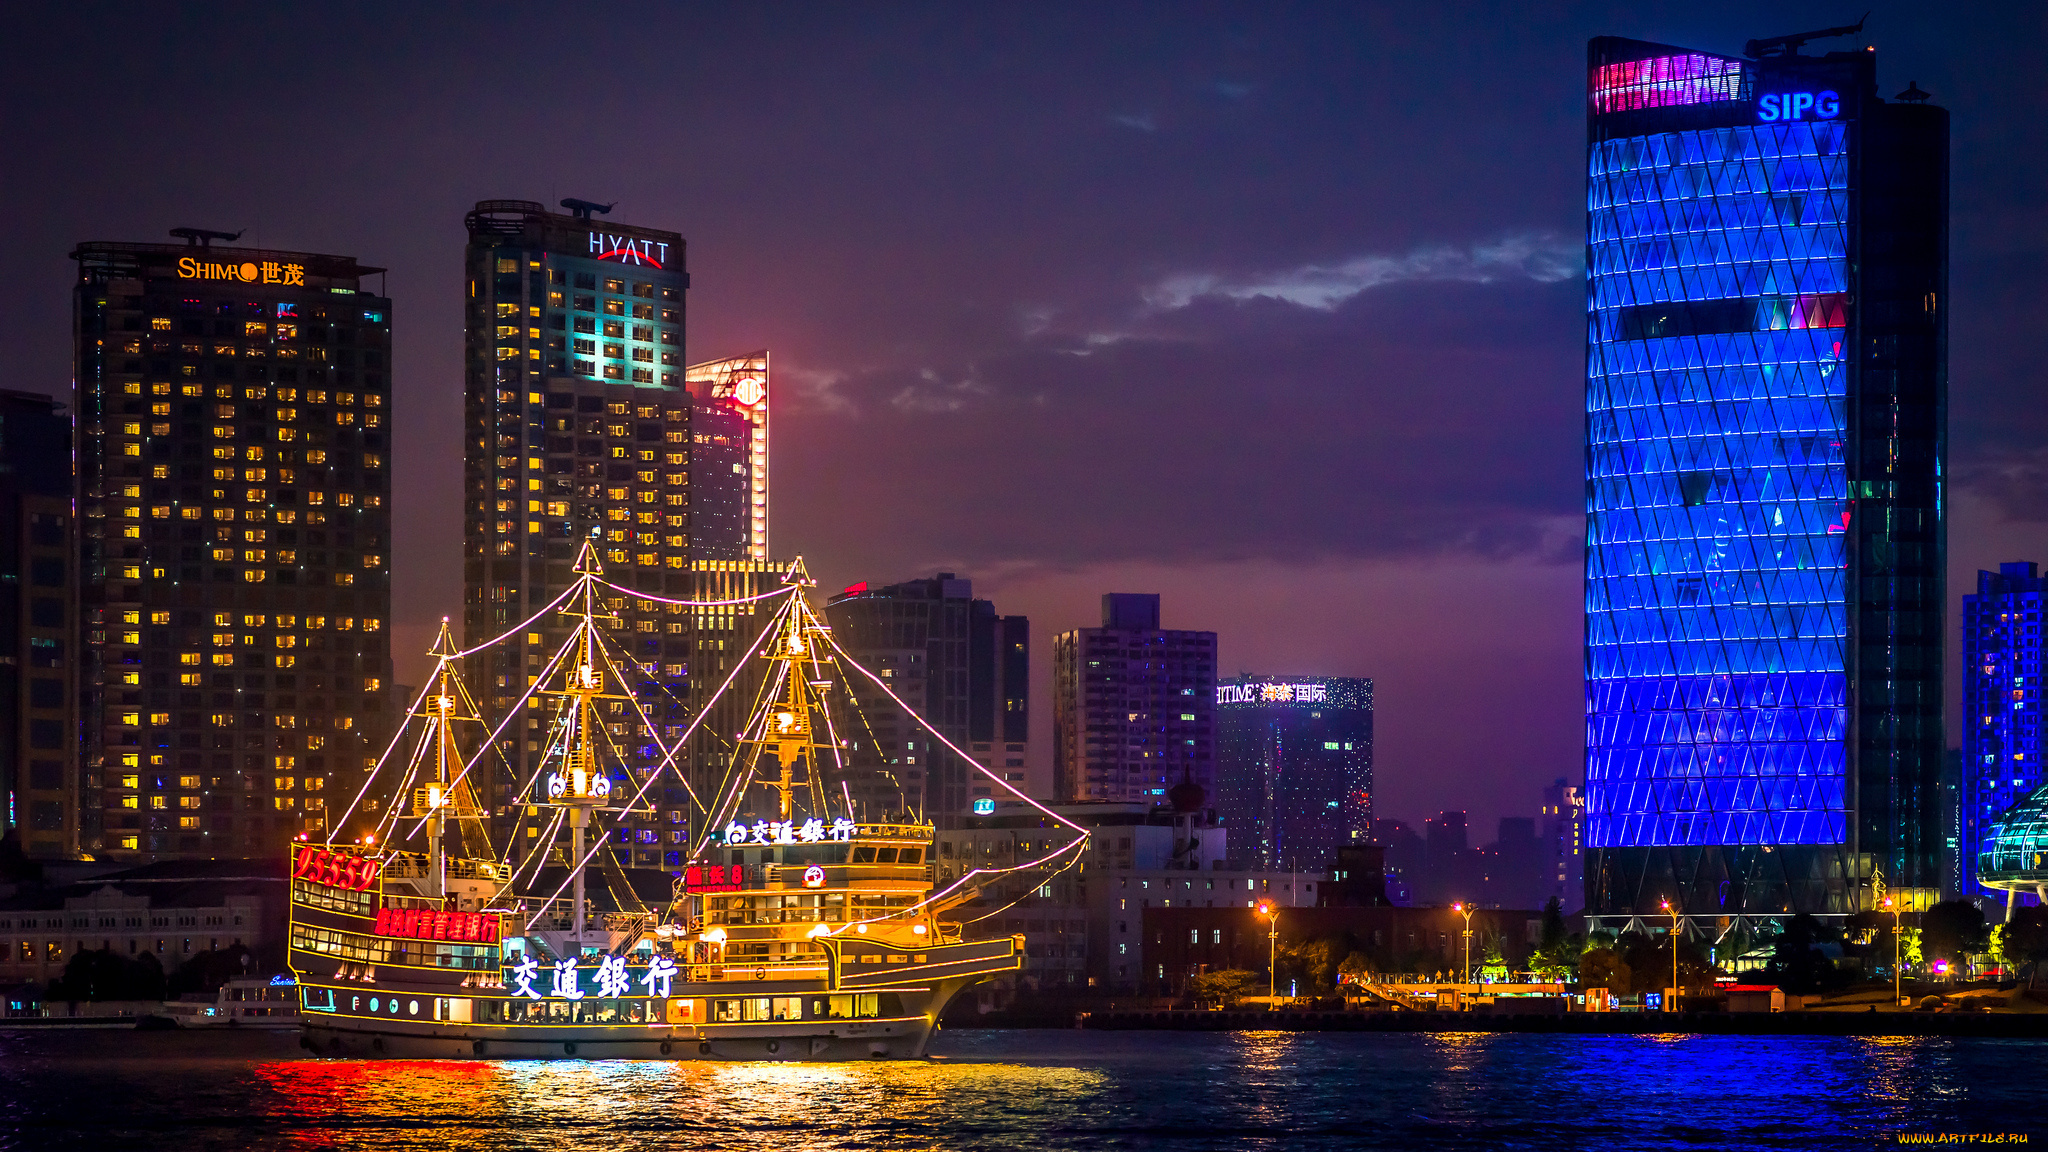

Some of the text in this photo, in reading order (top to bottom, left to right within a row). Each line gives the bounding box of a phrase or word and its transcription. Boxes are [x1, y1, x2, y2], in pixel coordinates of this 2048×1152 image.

[1758, 90, 1840, 121] SIPG
[589, 231, 668, 265] HYATT
[260, 261, 304, 287] 世茂
[293, 846, 378, 892] 95559
[511, 953, 679, 1000] 交通銀行
